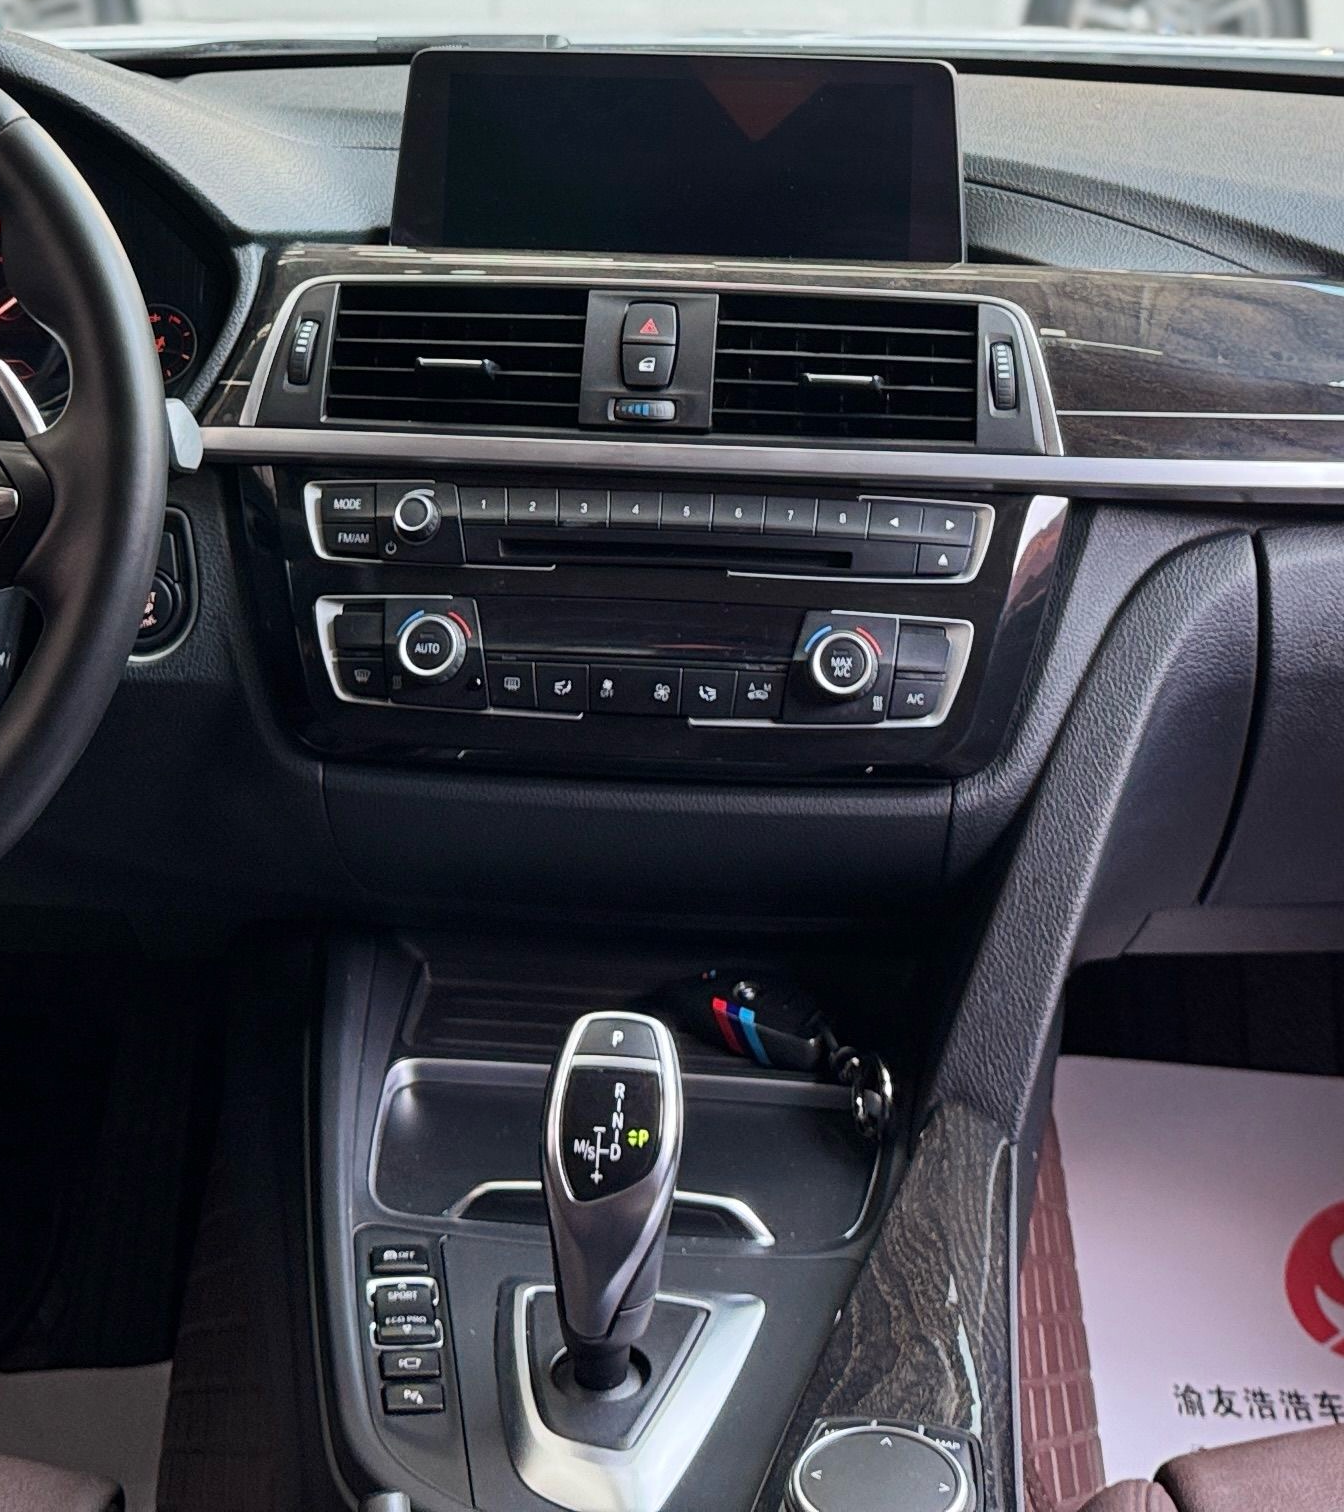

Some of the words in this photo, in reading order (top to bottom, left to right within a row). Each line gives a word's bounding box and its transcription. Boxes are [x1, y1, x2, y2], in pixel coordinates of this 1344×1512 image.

[333, 498, 362, 510] MODE
[480, 498, 487, 510] 1
[528, 500, 537, 512] 2
[580, 502, 588, 514] 3
[631, 503, 640, 515] 4
[683, 505, 691, 517] 5
[734, 507, 743, 519] 6
[787, 509, 795, 521] 7
[839, 512, 847, 524] 8
[337, 532, 370, 544] FM/AM
[414, 642, 441, 654] AUTO
[830, 656, 854, 668] MAX
[833, 667, 851, 678] A/C
[906, 692, 925, 706] A/C
[611, 1030, 625, 1048] P
[614, 1082, 626, 1099] R
[611, 1112, 624, 1131] N
[638, 1129, 650, 1148] P
[609, 1143, 622, 1162] D
[387, 1289, 419, 1302] SPORT
